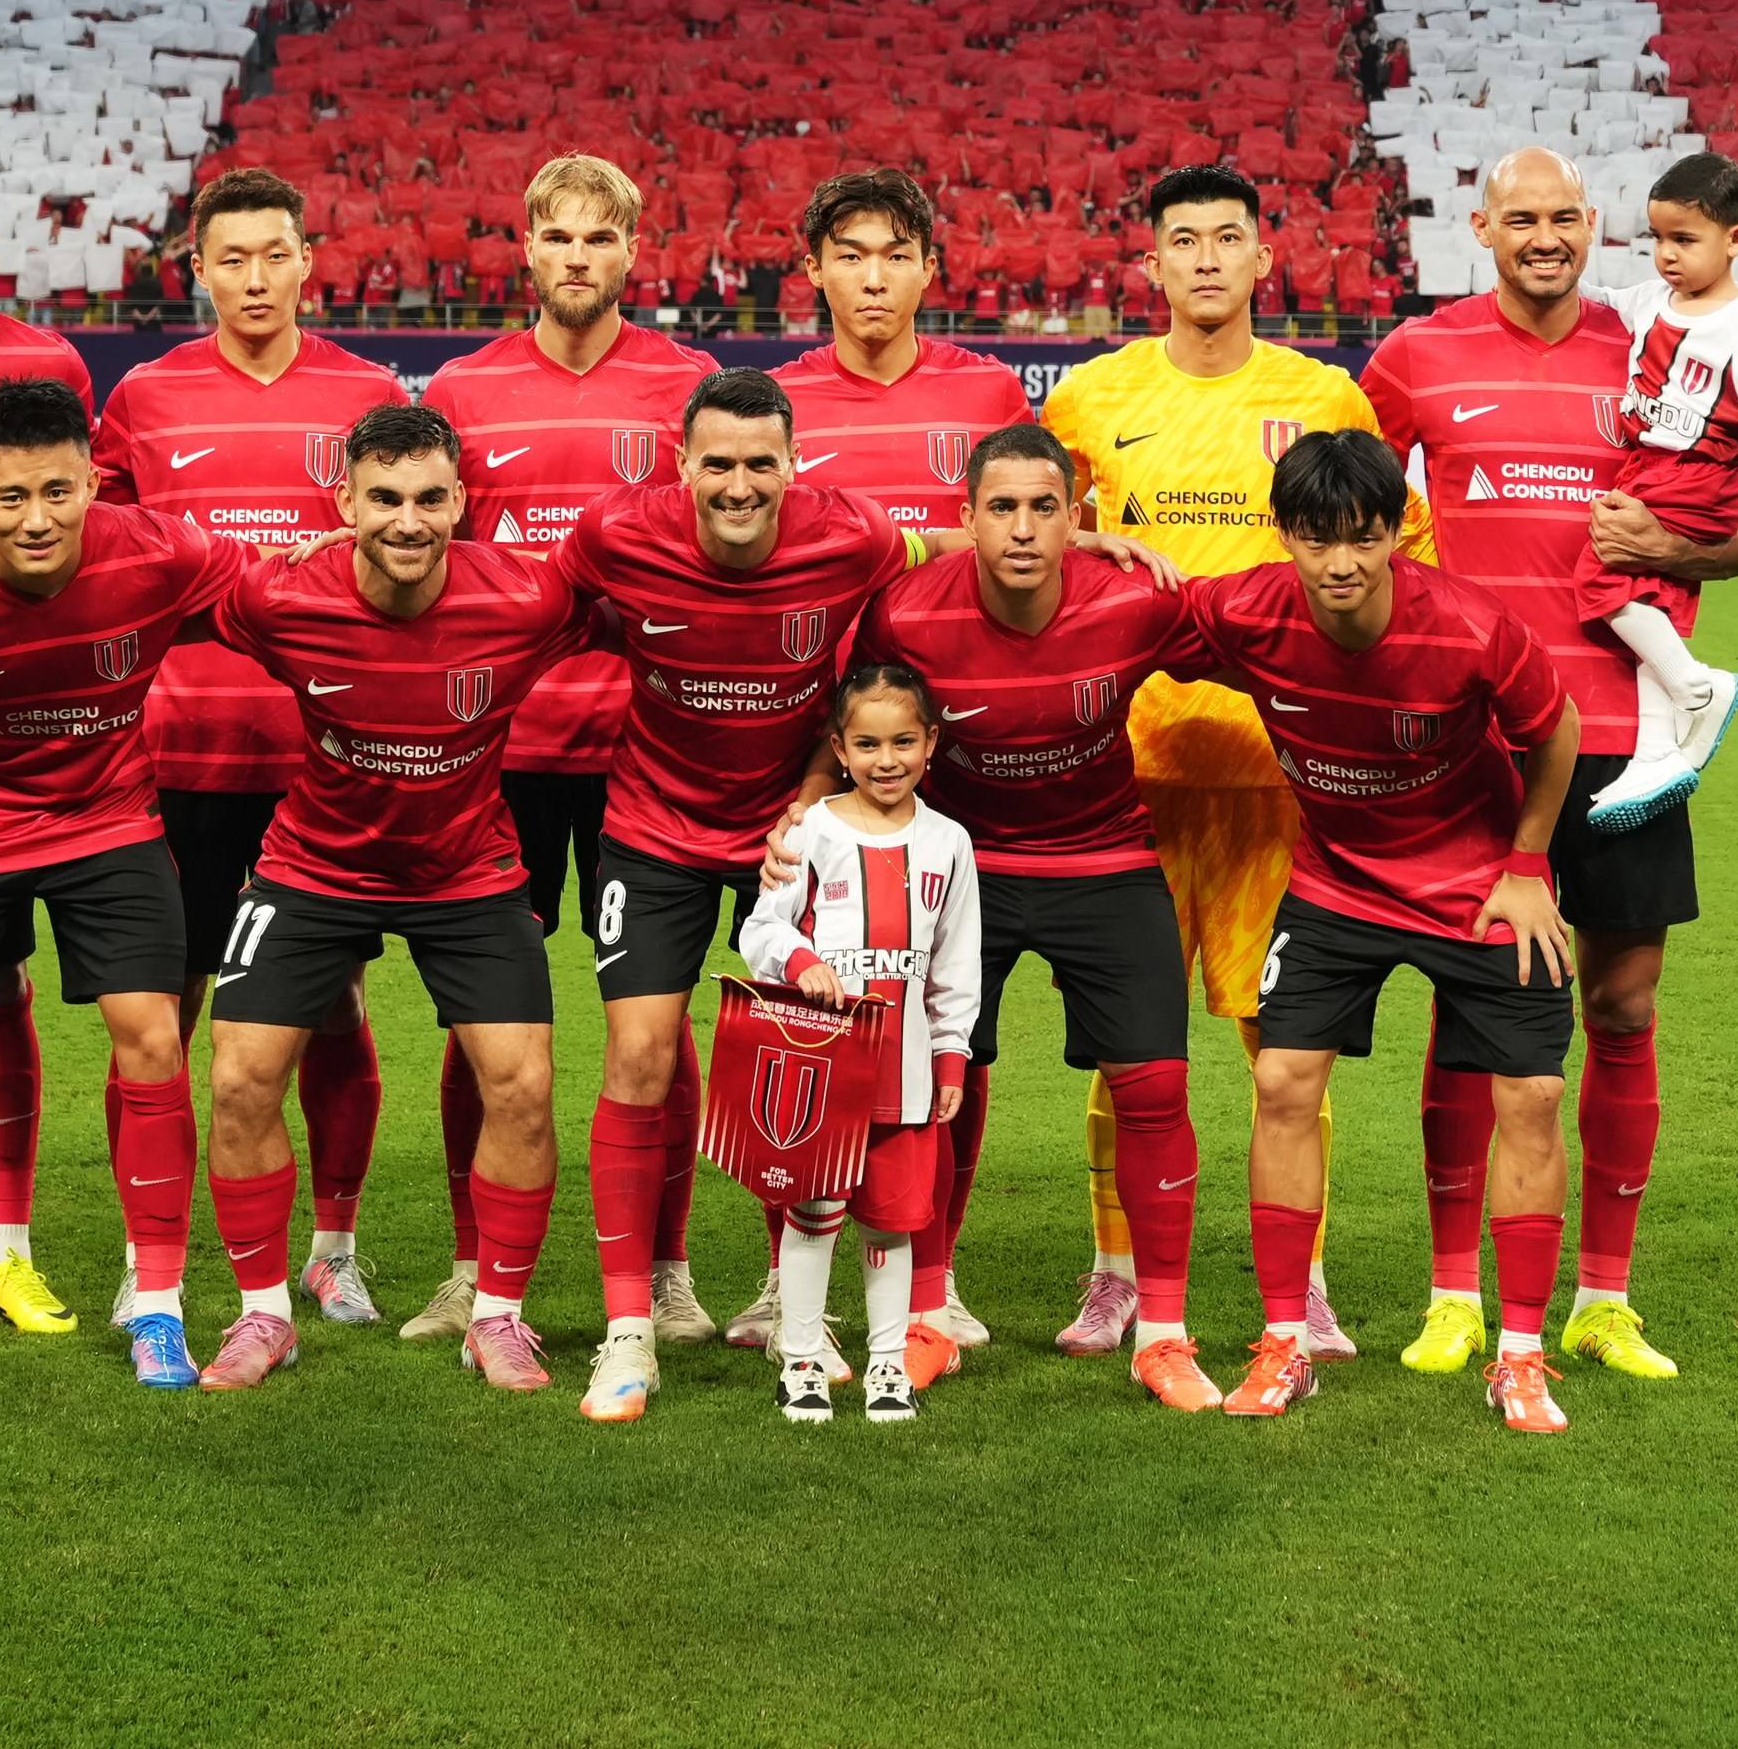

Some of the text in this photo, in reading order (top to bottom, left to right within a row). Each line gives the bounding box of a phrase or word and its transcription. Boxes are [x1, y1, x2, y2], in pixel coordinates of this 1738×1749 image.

[1501, 462, 1594, 482] CHENGDU
[1155, 491, 1247, 506] CHENGDU
[209, 508, 300, 524] CHENGDU
[1155, 511, 1280, 528] CONSTRUCTI
[679, 679, 778, 695] CHENGDU
[680, 680, 819, 711] CONSTRUCTION
[5, 706, 100, 722] CHENGDU
[7, 708, 143, 736] CONSTRUCTIO
[351, 738, 444, 759] CHENGDU
[981, 744, 1075, 765] CHENGDU
[982, 729, 1116, 778] CONSTRUCTION
[352, 744, 487, 777] CONSTRUCTION
[1306, 758, 1397, 782] CHENGDU
[1308, 761, 1451, 796] CONSTRUCTION
[598, 880, 626, 946] 8
[224, 900, 276, 968] 11
[788, 1017, 841, 1035] RONGCHENG
[761, 1171, 794, 1185] BETTER
[770, 1166, 787, 1176] FOR
[767, 1179, 787, 1191] CITY
